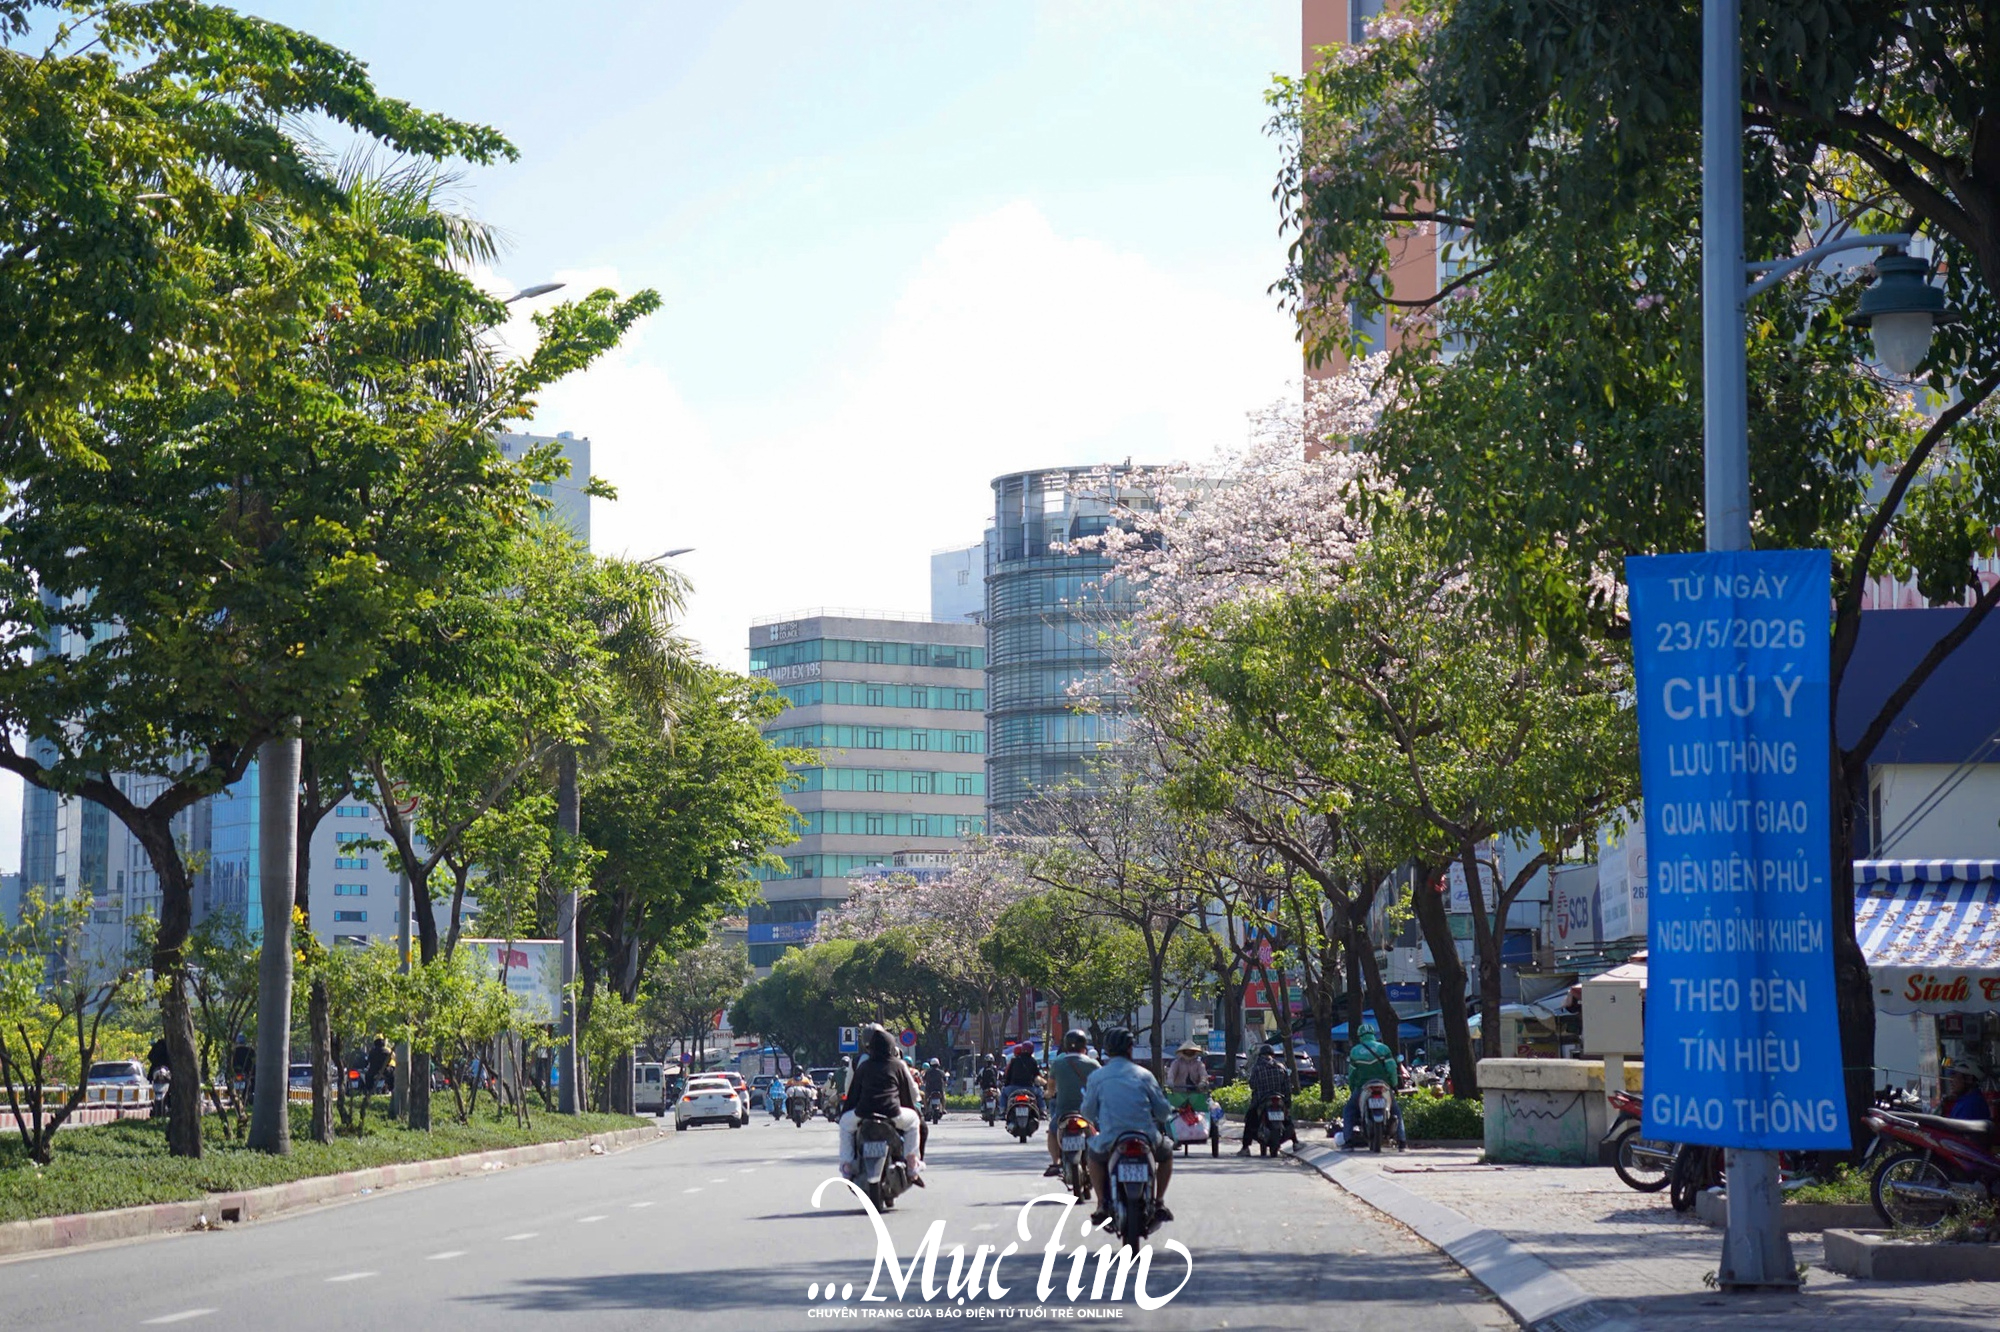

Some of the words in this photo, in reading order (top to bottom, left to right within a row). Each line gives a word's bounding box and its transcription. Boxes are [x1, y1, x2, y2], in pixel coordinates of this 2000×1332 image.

[1668, 570, 1704, 601] TỪ
[1714, 568, 1788, 599] NGÀY
[779, 621, 798, 631] BRITISH
[779, 630, 799, 639] COUNCIL
[1656, 619, 1806, 651] 23/5/2026
[805, 662, 821, 677] 195
[1663, 662, 1754, 720] CHÚ
[1773, 662, 1803, 718] Ý
[1668, 740, 1713, 776] LƯU
[1717, 733, 1797, 775] THÔNG
[1661, 802, 1706, 835] QUA
[1709, 790, 1751, 833] NÚT
[1755, 800, 1808, 834] GIAO
[1658, 853, 1708, 902] ĐIỆN
[1711, 852, 1758, 894] BIÊN
[1762, 848, 1809, 893] PHỦ
[1569, 896, 1589, 930] SCB
[1657, 906, 1721, 953] NGUYỄN
[1725, 907, 1766, 952] BỈNH
[1768, 912, 1824, 953] KHIÊM
[1670, 978, 1740, 1013] THEO
[1749, 969, 1808, 1013] ĐÈN
[1903, 973, 1971, 1003] Sinh
[1679, 1029, 1727, 1071] TÍN
[1734, 1031, 1801, 1080] HIỆU
[1652, 1094, 1724, 1131] GIAO
[1732, 1092, 1838, 1133] THÔNG
